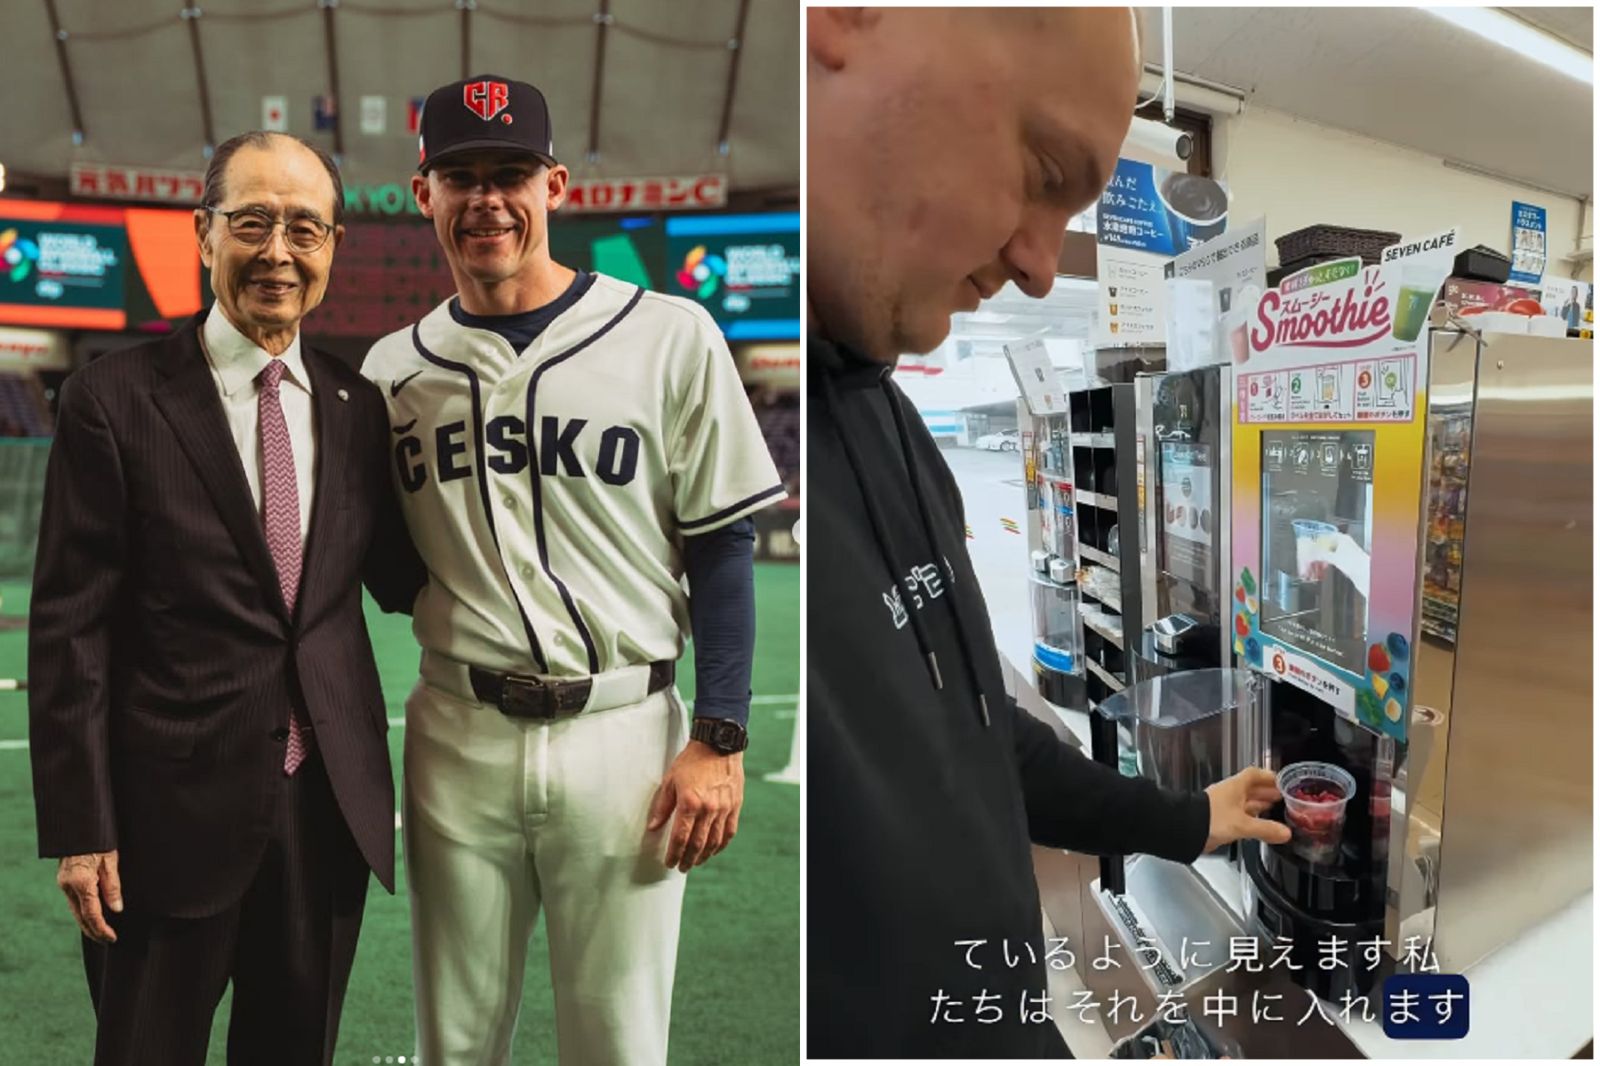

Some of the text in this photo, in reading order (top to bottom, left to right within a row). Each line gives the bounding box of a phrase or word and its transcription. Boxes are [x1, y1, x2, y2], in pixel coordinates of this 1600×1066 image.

[1385, 228, 1455, 263] SEVEN CAFÉ
[1250, 286, 1391, 352] Smoothie
[1280, 291, 1331, 316] スムージー
[394, 415, 641, 494] ČESKO
